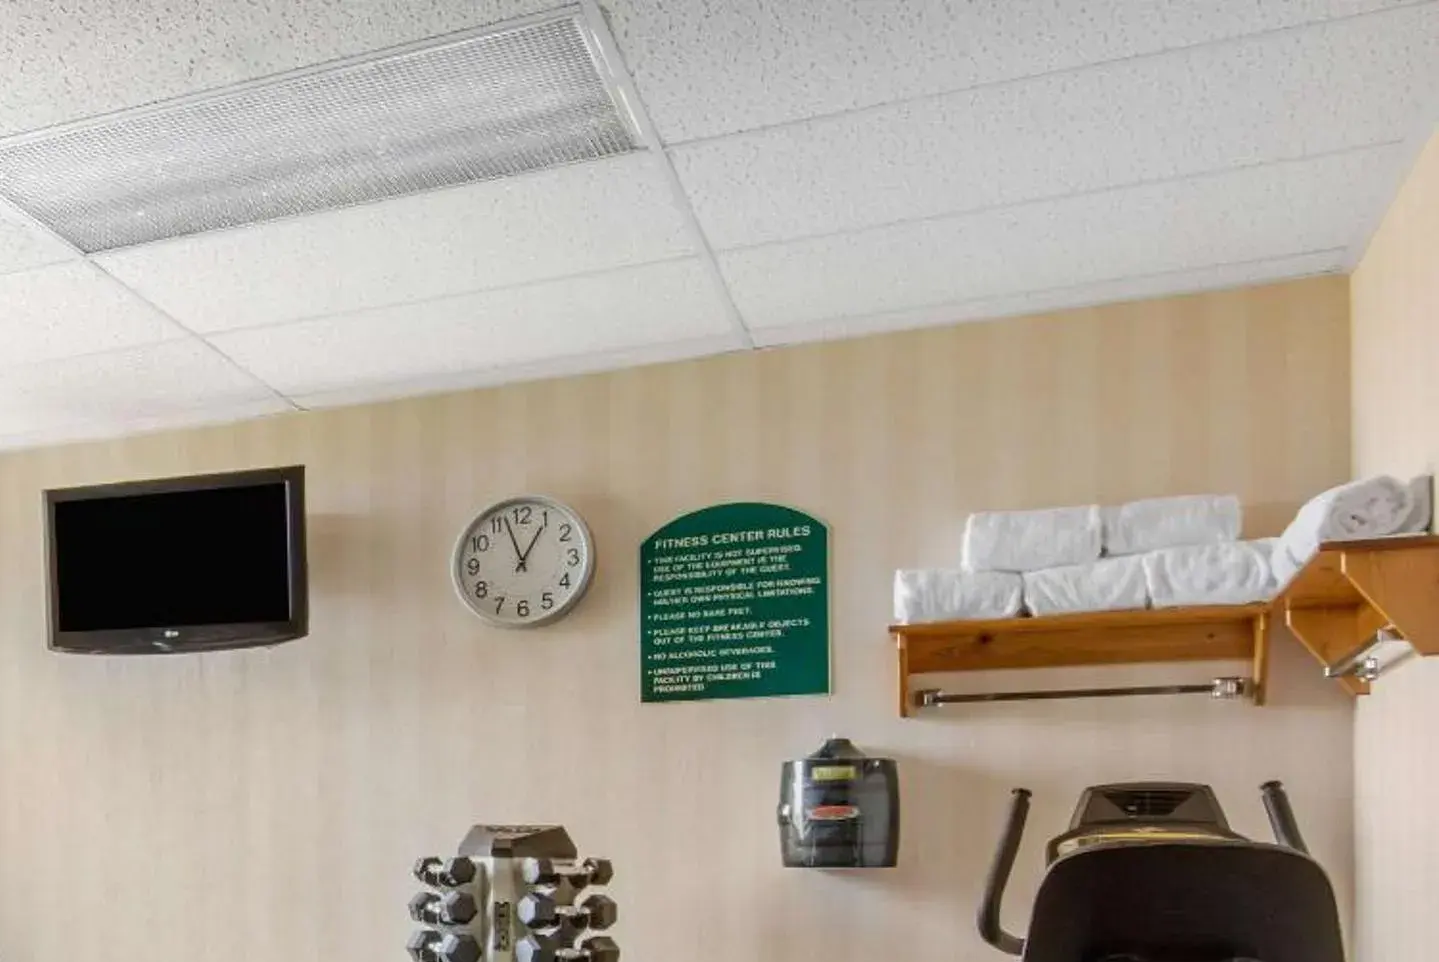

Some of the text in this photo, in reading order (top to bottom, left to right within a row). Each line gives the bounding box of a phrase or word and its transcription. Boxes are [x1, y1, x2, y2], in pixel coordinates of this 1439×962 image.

[513, 506, 532, 525] 12
[542, 511, 548, 528] 1
[491, 516, 502, 534] 11
[559, 523, 572, 542] 2
[471, 534, 490, 553] 10
[655, 525, 811, 549] FITNESS CENTER RULES
[566, 548, 580, 567] 3
[674, 552, 712, 562] FACILITY
[687, 562, 704, 570] THE
[770, 554, 787, 562] THE
[467, 558, 480, 576] 9
[724, 568, 737, 576] OF
[740, 566, 757, 575] THE
[475, 580, 488, 598] 8
[559, 572, 571, 590] 4
[757, 580, 775, 588] FOR
[494, 596, 505, 615] 7
[541, 592, 554, 610] 5
[690, 595, 711, 603] OWN
[517, 600, 530, 617] 6
[653, 611, 686, 621] PLEASE
[653, 627, 686, 636] PLEASE
[687, 625, 710, 634] KEEP
[653, 636, 671, 646] OUT
[673, 636, 685, 644] OF
[706, 632, 744, 642] FITNESS
[653, 652, 667, 660] NO
[668, 649, 717, 659] ALCOHOLIC
[653, 674, 691, 685] FACILITY
[692, 674, 704, 682] BY
